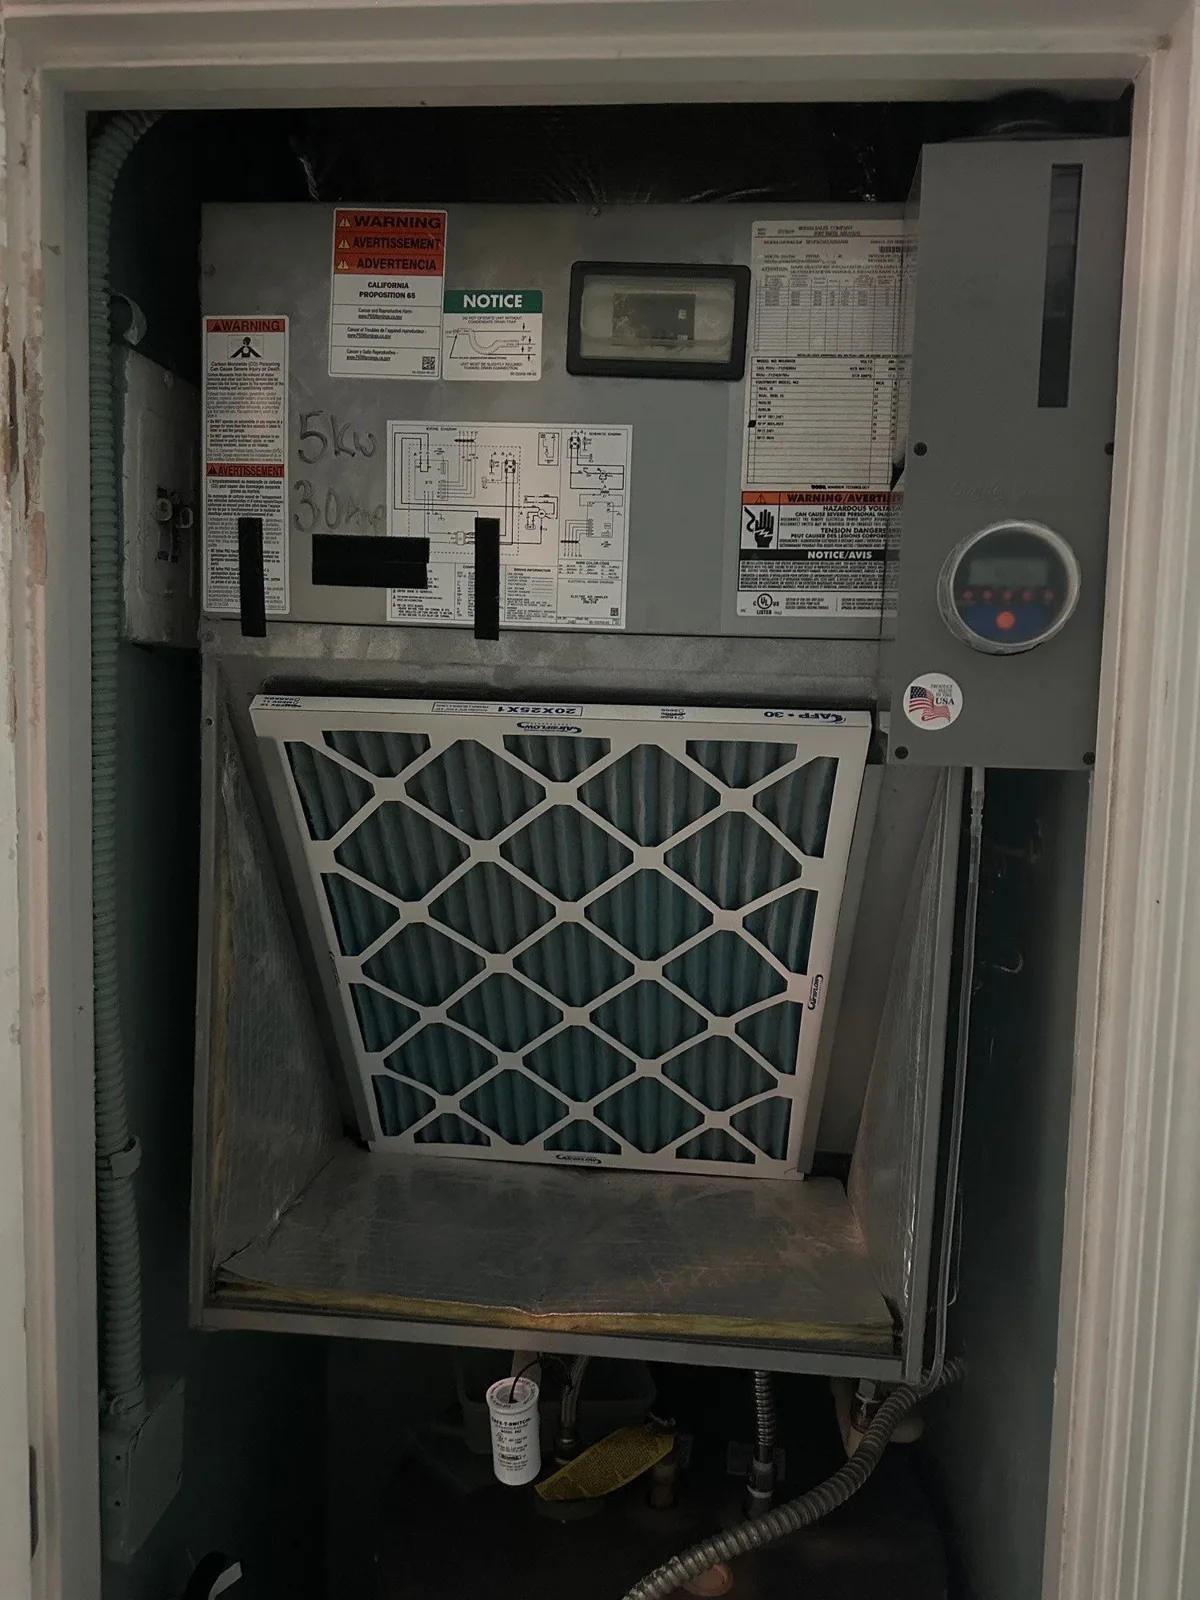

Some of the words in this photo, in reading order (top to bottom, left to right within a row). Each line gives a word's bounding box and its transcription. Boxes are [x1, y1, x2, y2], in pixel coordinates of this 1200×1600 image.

[354, 215, 440, 229] WARNING
[352, 236, 442, 250] AVERTISSEMENT
[356, 258, 437, 271] ADVERTENCIA
[359, 291, 405, 299] PROPOSITION
[463, 294, 522, 308] NOTICE
[222, 320, 280, 331] WARNING
[218, 465, 284, 476] AVERTISSEMENT
[808, 551, 873, 559] NOTICE/AVIS
[496, 705, 576, 714] 20X25X1
[798, 713, 832, 721] AFP
